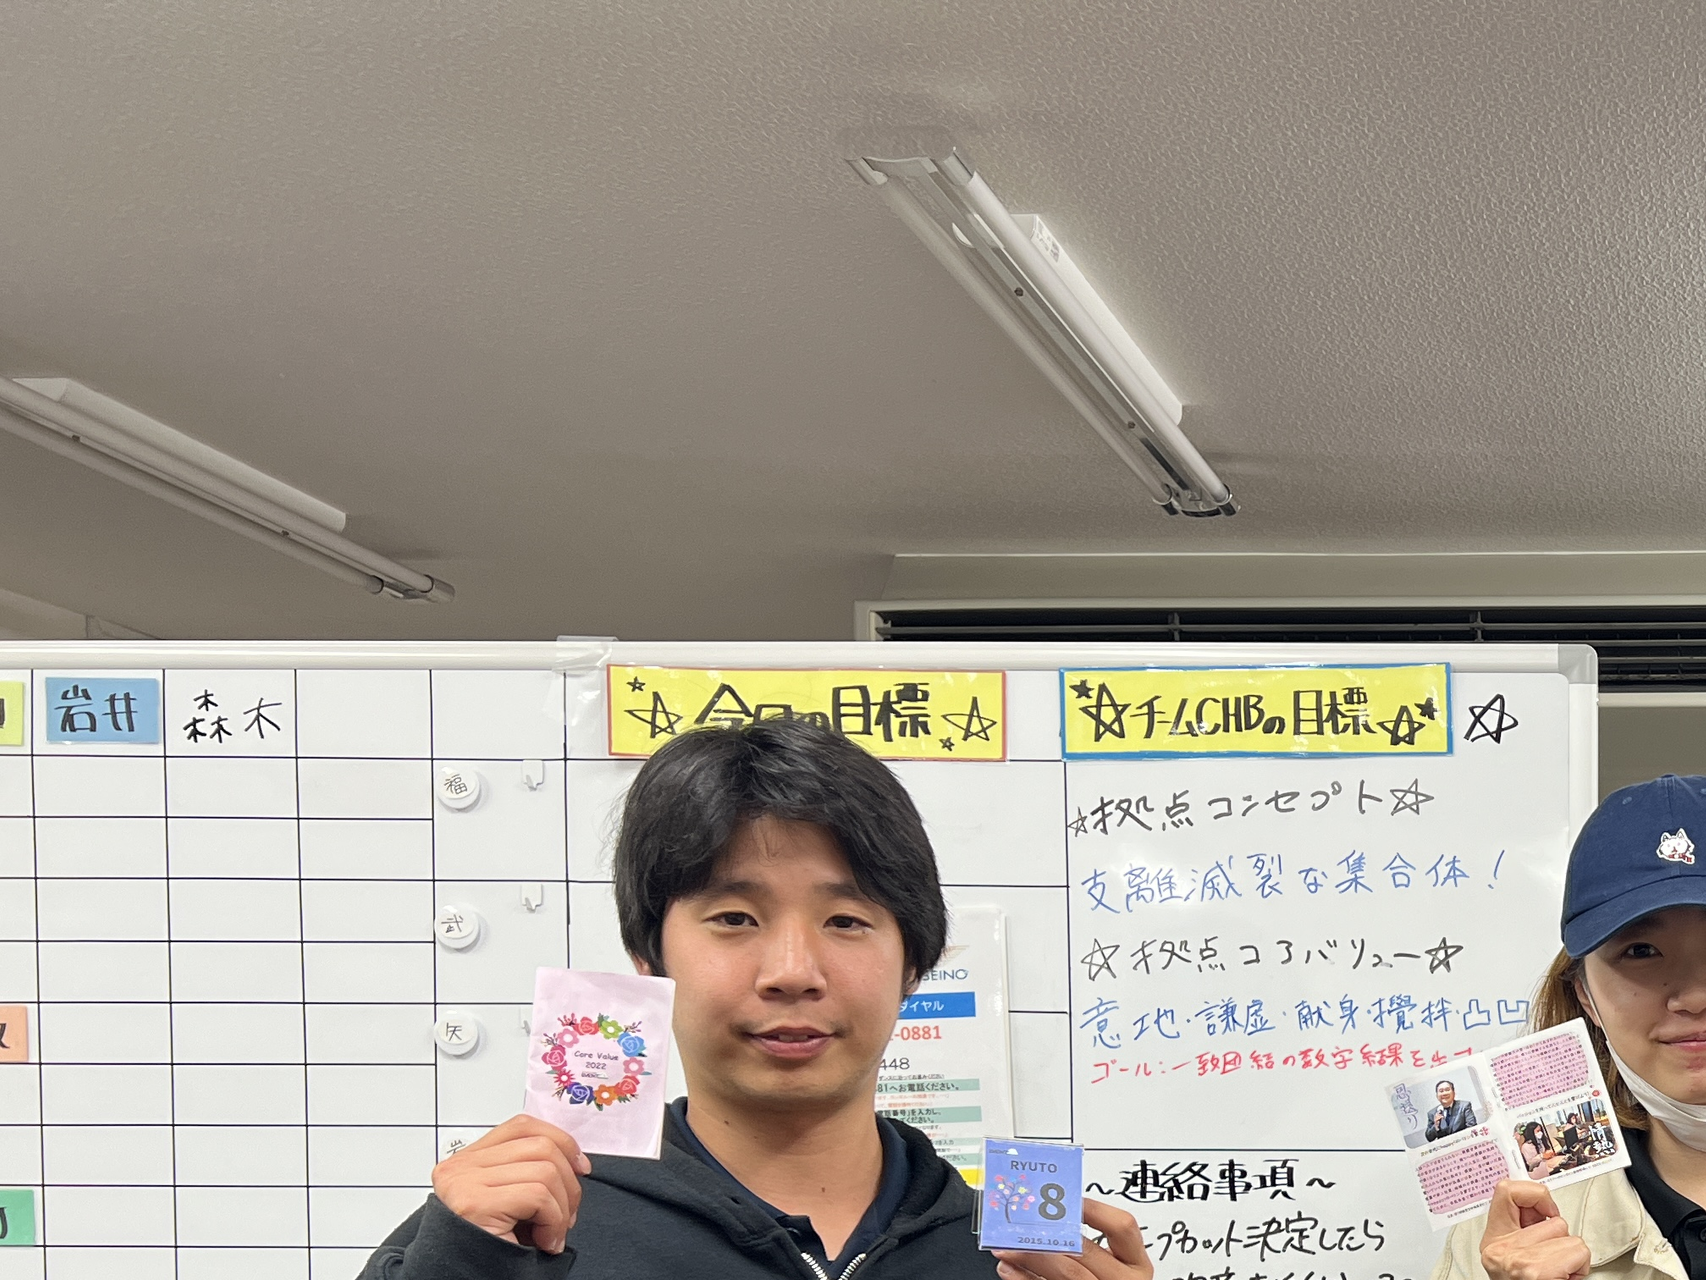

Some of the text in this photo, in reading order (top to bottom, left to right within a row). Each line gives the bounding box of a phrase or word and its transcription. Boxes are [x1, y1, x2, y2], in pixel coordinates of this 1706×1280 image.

[54, 685, 138, 732] 岩井
[183, 689, 282, 743] 森木
[1130, 686, 1376, 746] チームCHBの目標
[443, 774, 468, 795] 福
[1092, 780, 1382, 834] 拠点コンセプト
[445, 1022, 462, 1041] 矢
[889, 1026, 942, 1041] -0881
[574, 1050, 619, 1061] Core Value
[585, 1062, 607, 1070] 2022
[876, 1082, 960, 1093] 81へお電話ください。
[1010, 1160, 1057, 1173] RYUTO
[1038, 1183, 1066, 1220] 8
[1140, 1211, 1385, 1262] プカット決定したら
